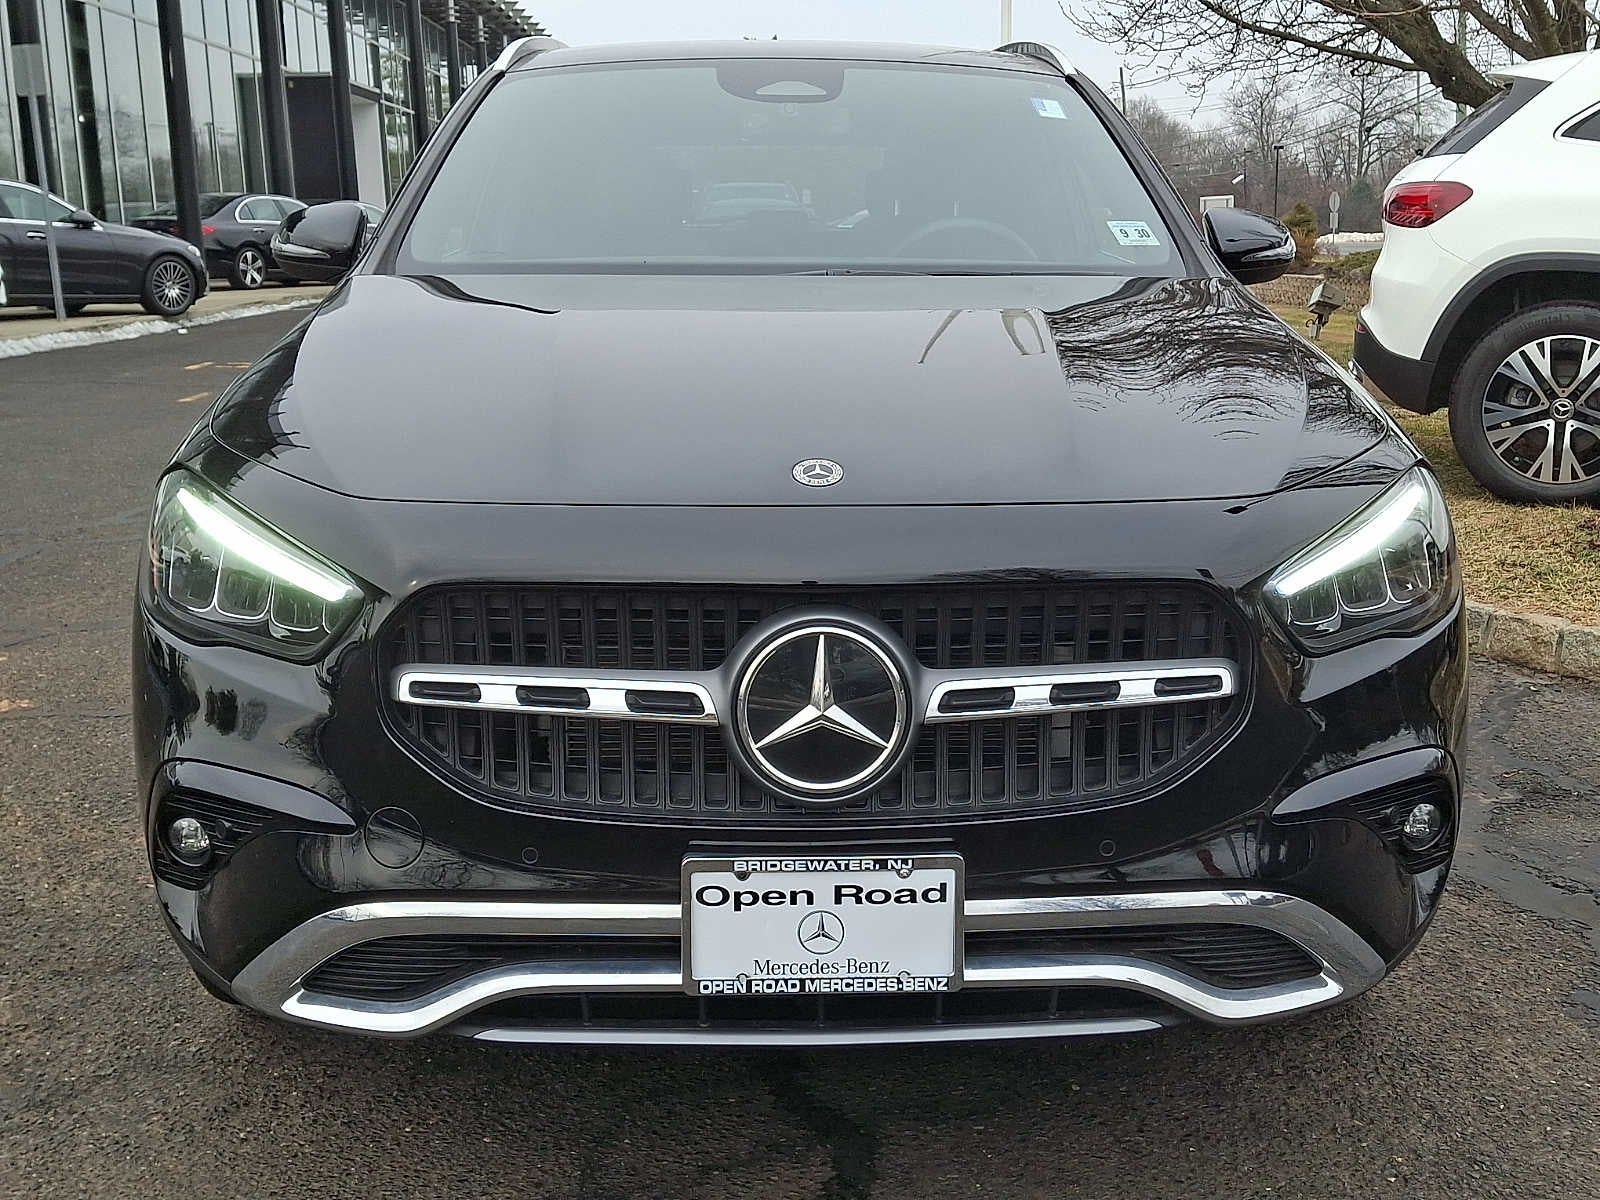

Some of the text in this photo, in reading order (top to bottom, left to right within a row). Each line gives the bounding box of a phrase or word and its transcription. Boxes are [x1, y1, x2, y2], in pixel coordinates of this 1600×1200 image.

[1119, 228, 1150, 238] 9 30
[733, 859, 913, 872] BRIDGEWATER, NJ
[695, 882, 947, 912] Open Road
[753, 958, 890, 976] Mercedes-Benz
[699, 979, 746, 994] OPEN
[751, 979, 800, 993] ROAD
